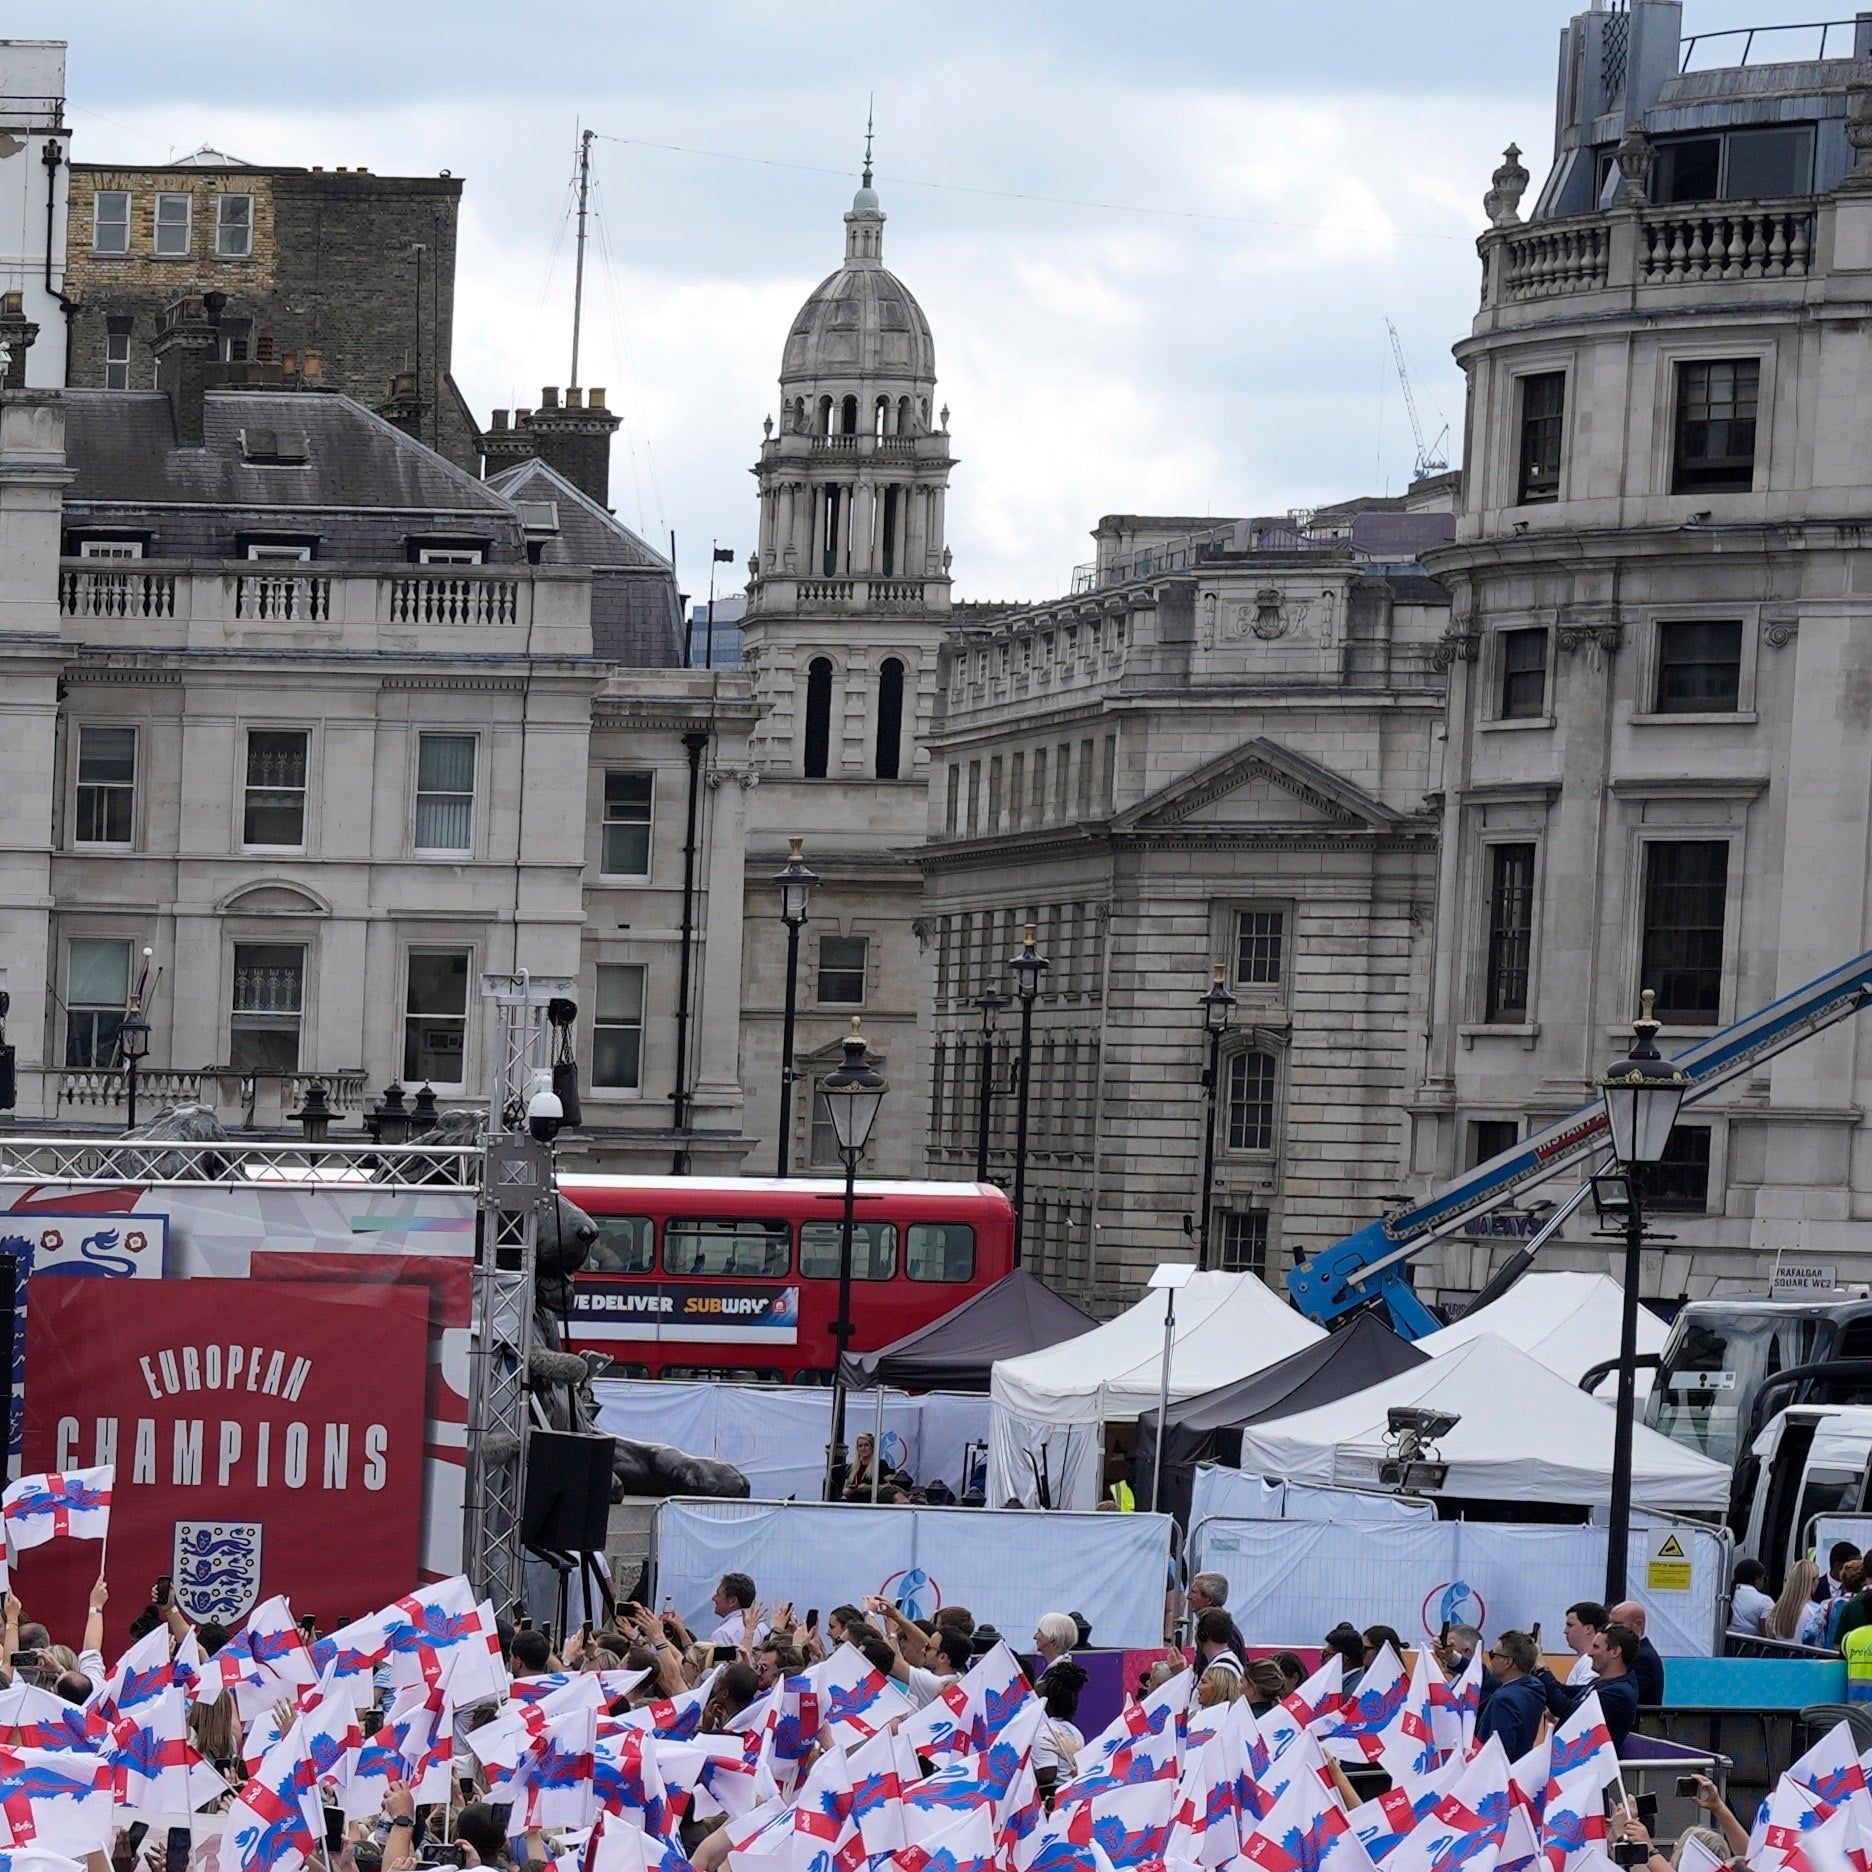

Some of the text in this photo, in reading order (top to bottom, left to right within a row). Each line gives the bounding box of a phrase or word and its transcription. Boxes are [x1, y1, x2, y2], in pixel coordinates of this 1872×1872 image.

[1773, 1278, 1832, 1288] SQUARE WC2
[592, 1294, 674, 1313] DELIVER
[683, 1297, 770, 1316] SUBWAY
[138, 1343, 312, 1403] EUROPEAN
[56, 1415, 388, 1492] CHAMPIONS
